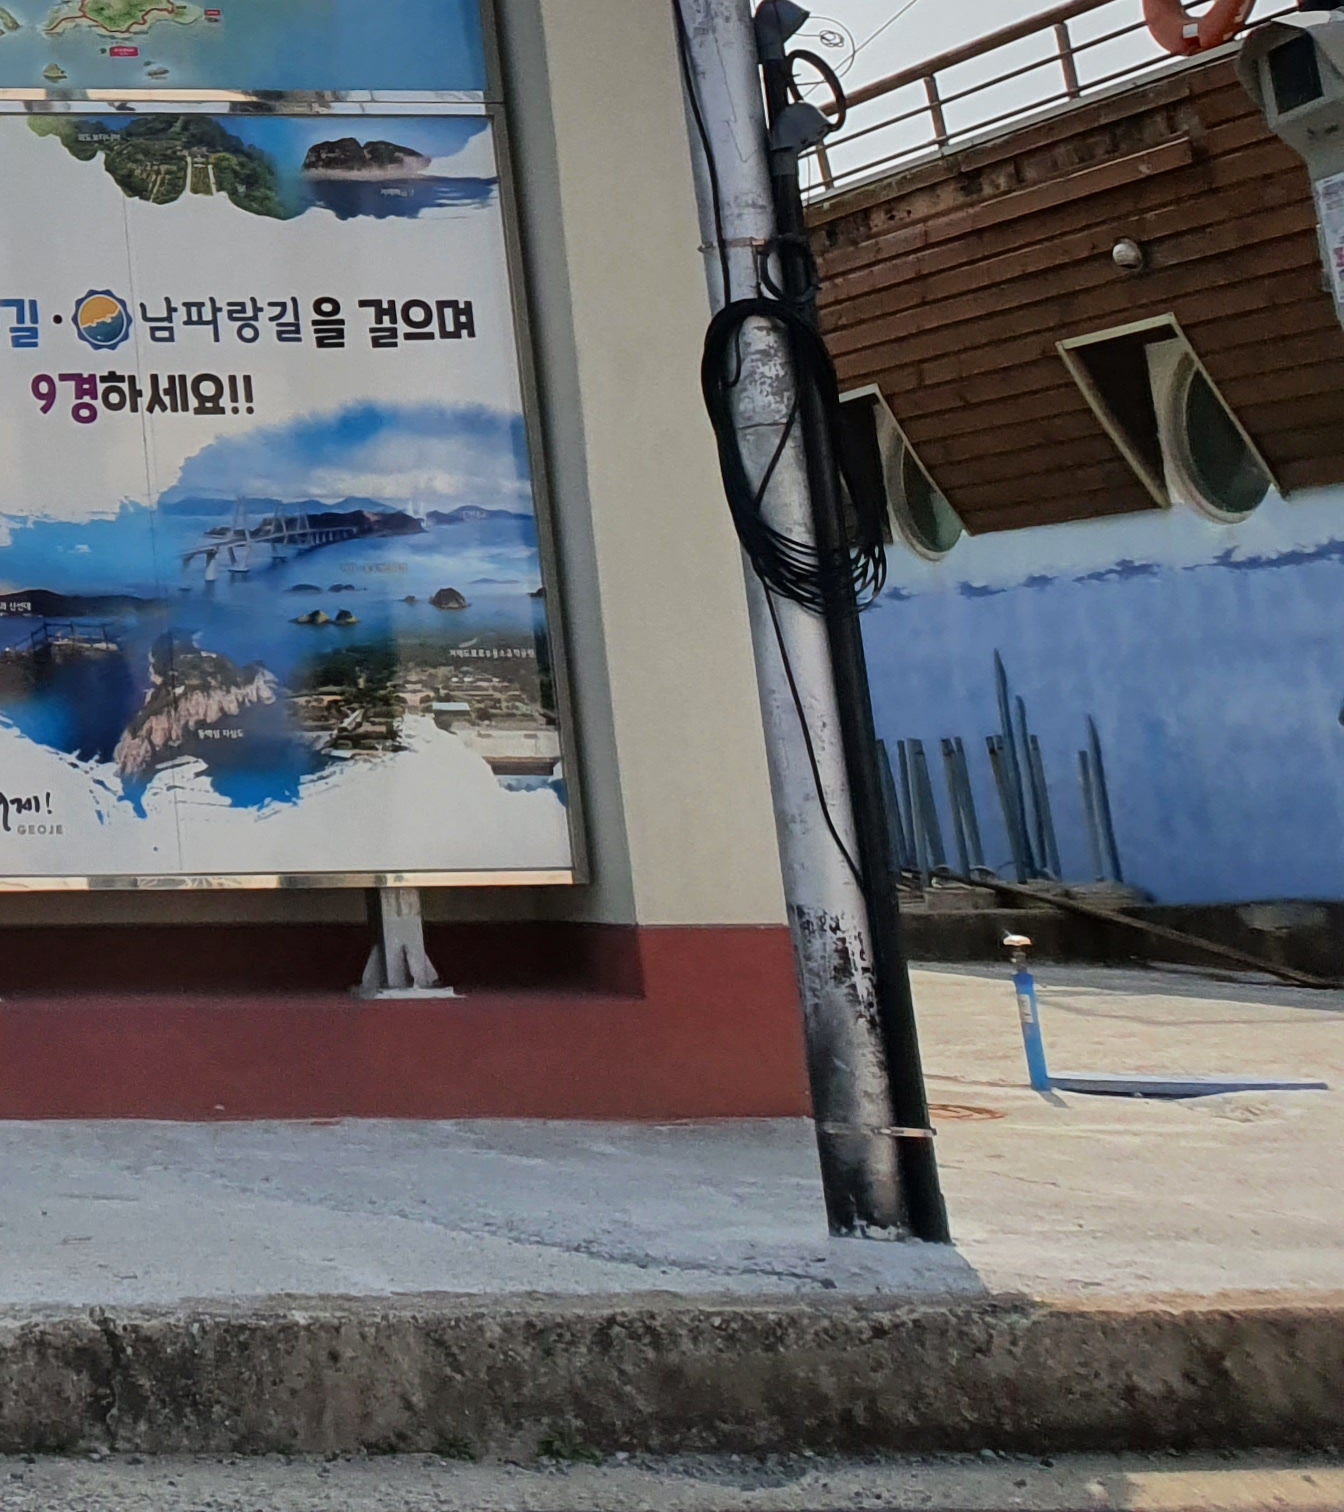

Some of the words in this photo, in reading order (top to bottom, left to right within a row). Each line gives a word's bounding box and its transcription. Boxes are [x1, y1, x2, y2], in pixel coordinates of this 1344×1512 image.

[358, 299, 476, 349] 걸으며
[31, 371, 255, 424] 9경하세요!!
[17, 825, 63, 835] GEOJE
